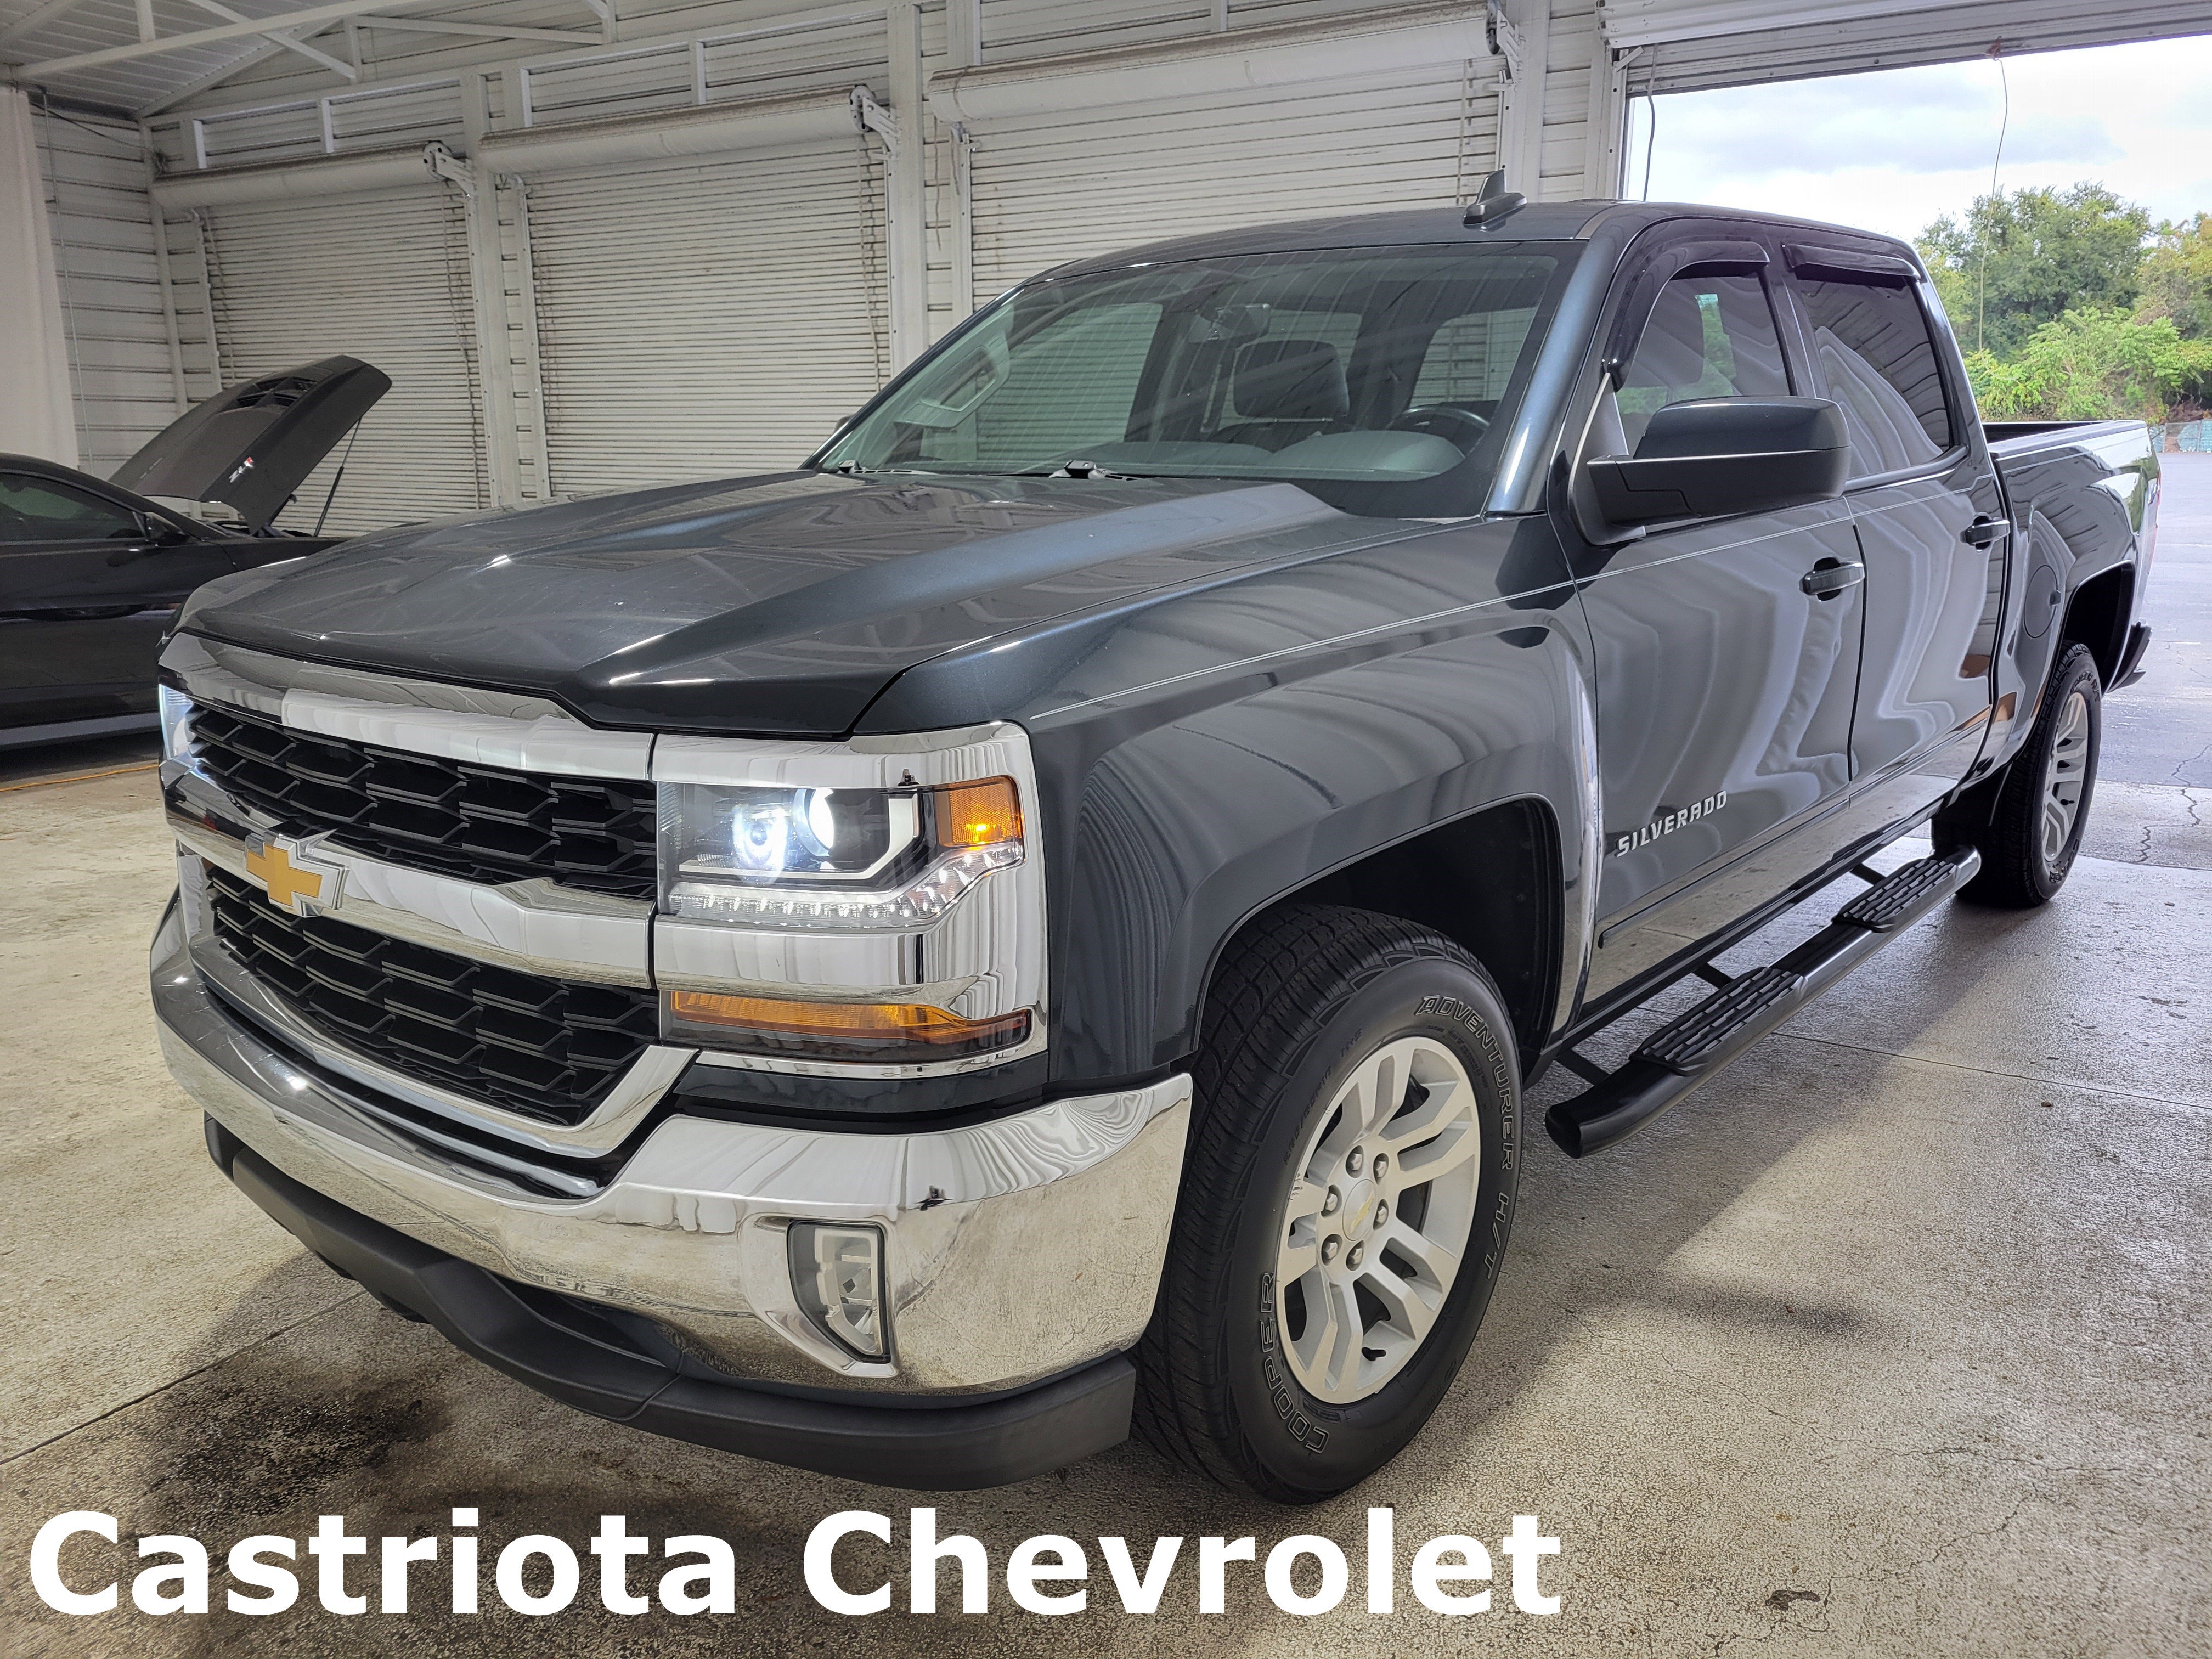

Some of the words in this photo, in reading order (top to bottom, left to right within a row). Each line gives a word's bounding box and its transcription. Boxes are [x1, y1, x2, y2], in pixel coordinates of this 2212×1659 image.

[1616, 790, 1728, 857] SILVERADO
[1414, 994, 1514, 1170] ADVENTURER
[1483, 1192, 1510, 1280] H/T
[1259, 1272, 1329, 1453] COOPER
